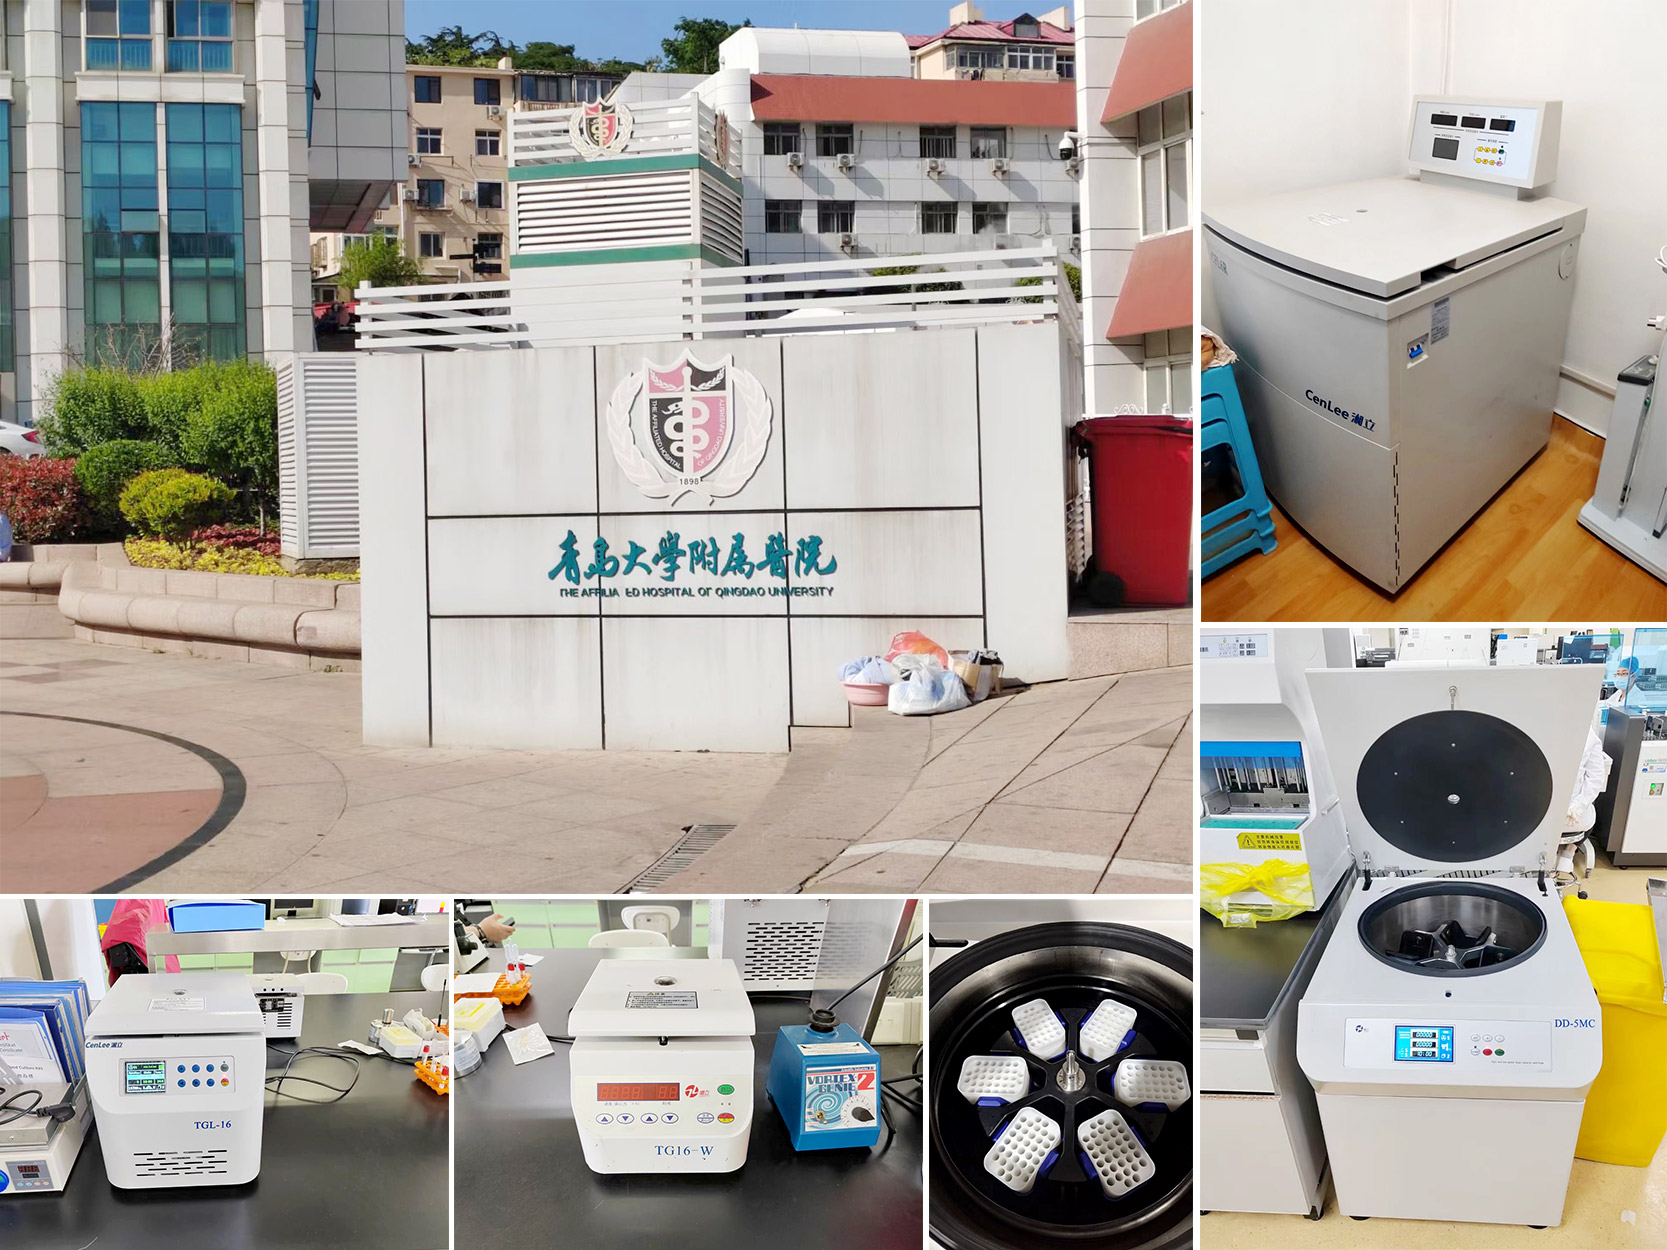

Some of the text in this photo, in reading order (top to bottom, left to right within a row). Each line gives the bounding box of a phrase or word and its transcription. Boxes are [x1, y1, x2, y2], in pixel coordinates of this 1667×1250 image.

[1305, 389, 1349, 420] CenLee
[659, 447, 682, 469] HOSPITAL
[560, 588, 579, 598] THE
[642, 587, 696, 598] HOSPITAL
[715, 587, 766, 599] QINGDAO
[768, 587, 834, 597] UNIVERSITY
[1554, 1018, 1596, 1029] DD-5MC
[857, 1072, 876, 1091] 2
[818, 1083, 857, 1093] GENIE
[194, 1120, 232, 1130] TGL-16
[654, 1145, 714, 1156] TG16-W
